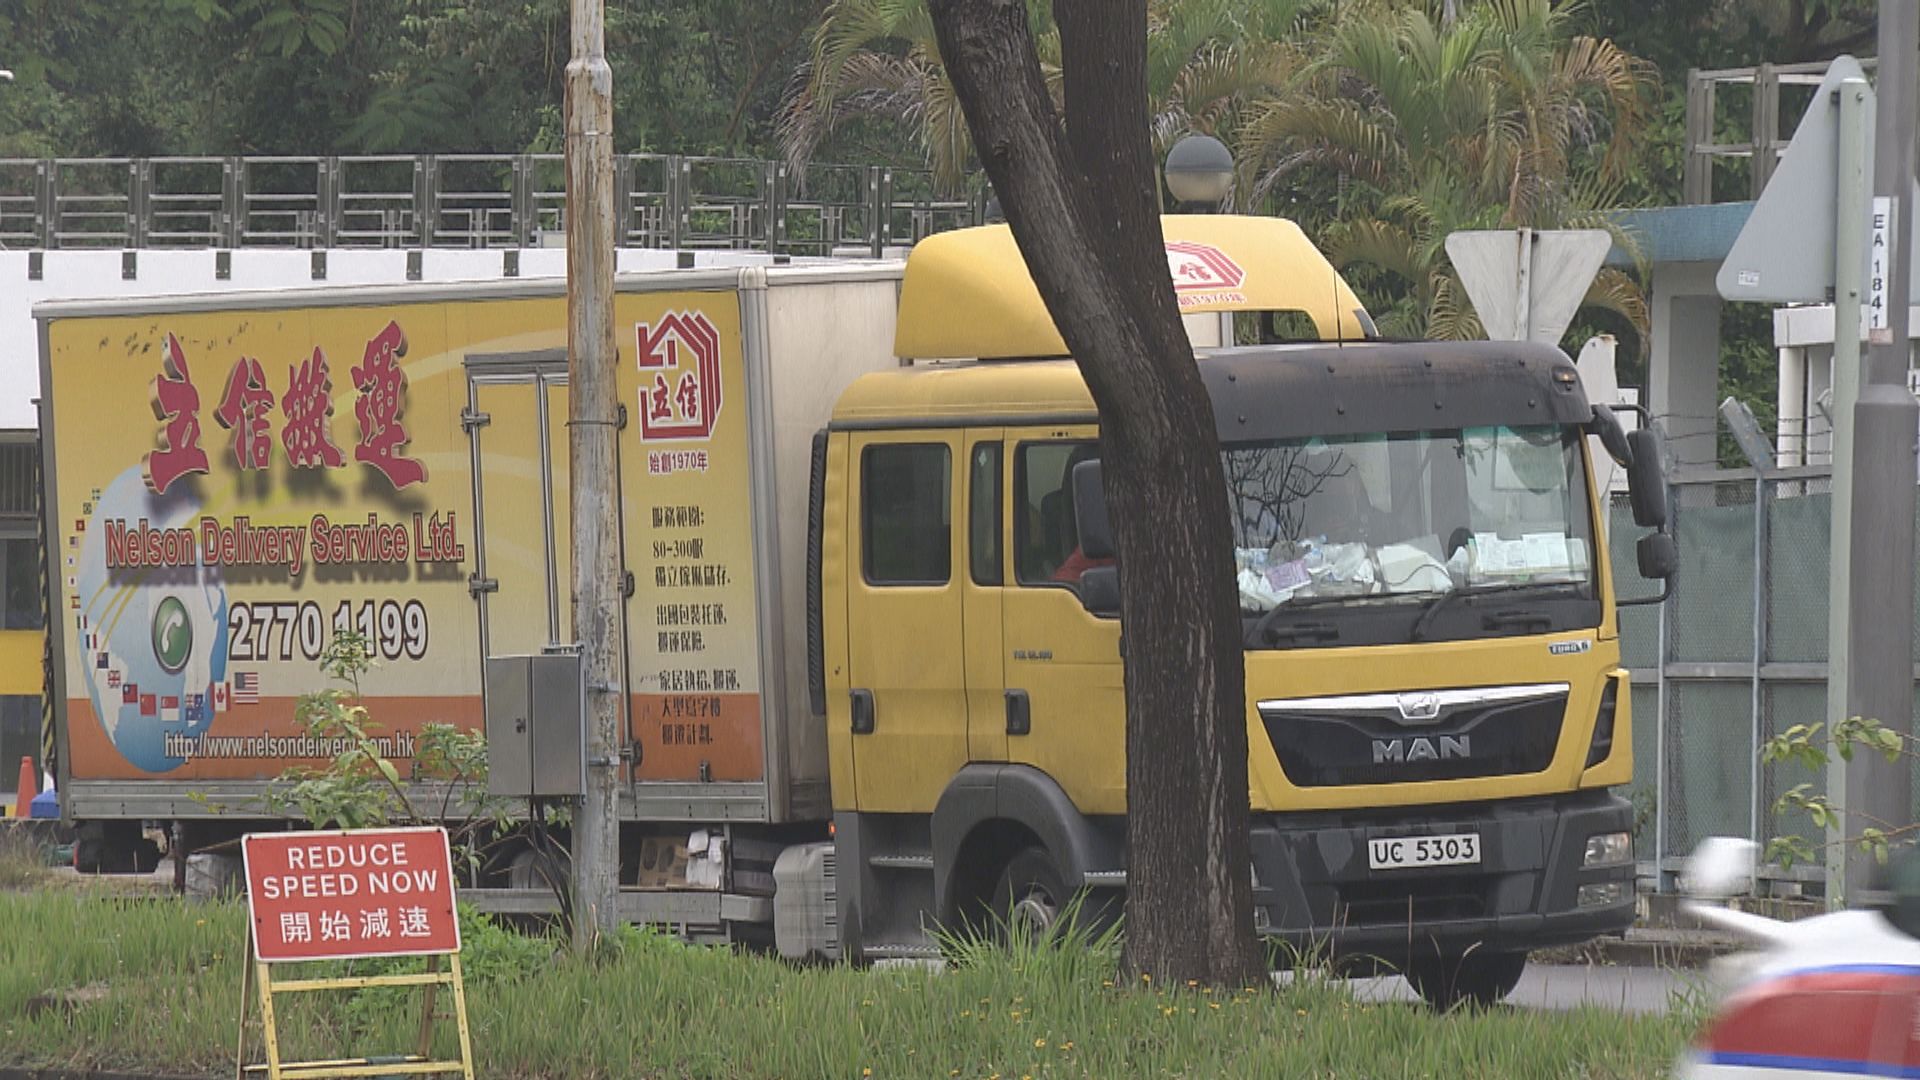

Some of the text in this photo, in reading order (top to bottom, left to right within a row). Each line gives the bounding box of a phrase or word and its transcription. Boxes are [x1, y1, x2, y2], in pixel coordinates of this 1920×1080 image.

[1871, 214, 1885, 327] EA 1841
[650, 374, 698, 421] 立信
[649, 451, 708, 473] 始創1970年
[105, 510, 464, 576] Nelson Delivery Service Ltd.
[228, 598, 428, 661] 2770 1199
[1372, 734, 1471, 763] MAN
[288, 842, 408, 869] REDUCE
[1374, 838, 1474, 863] UC 5303
[263, 869, 438, 899] SPEED NOW
[280, 905, 431, 943] 開始減速
